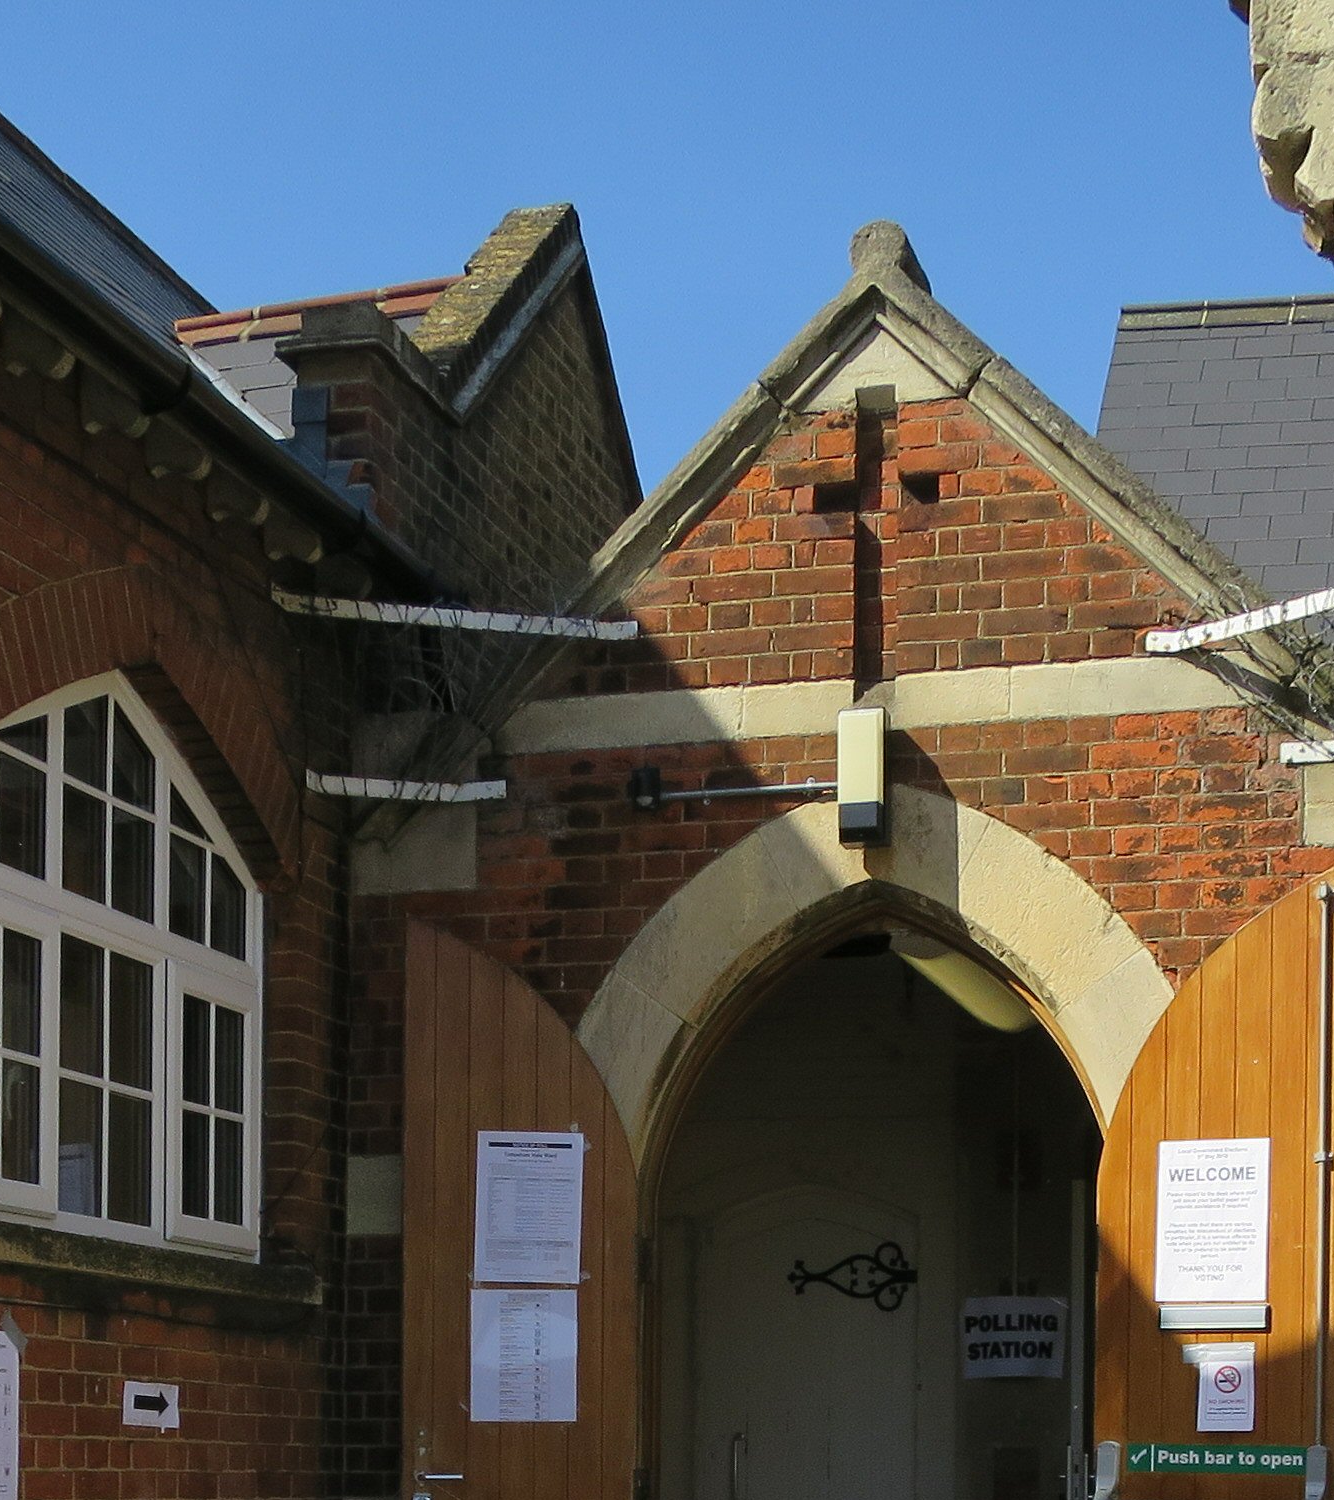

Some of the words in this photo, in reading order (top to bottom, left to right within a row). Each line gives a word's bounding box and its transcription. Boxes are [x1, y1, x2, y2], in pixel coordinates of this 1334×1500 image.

[1169, 1166, 1256, 1182] WELCOME
[964, 1314, 1059, 1333] POLLING
[967, 1341, 1053, 1361] STATION
[1157, 1448, 1200, 1466] Push
[1204, 1449, 1234, 1466] bar
[1238, 1451, 1256, 1466] to
[1260, 1453, 1304, 1470] open
